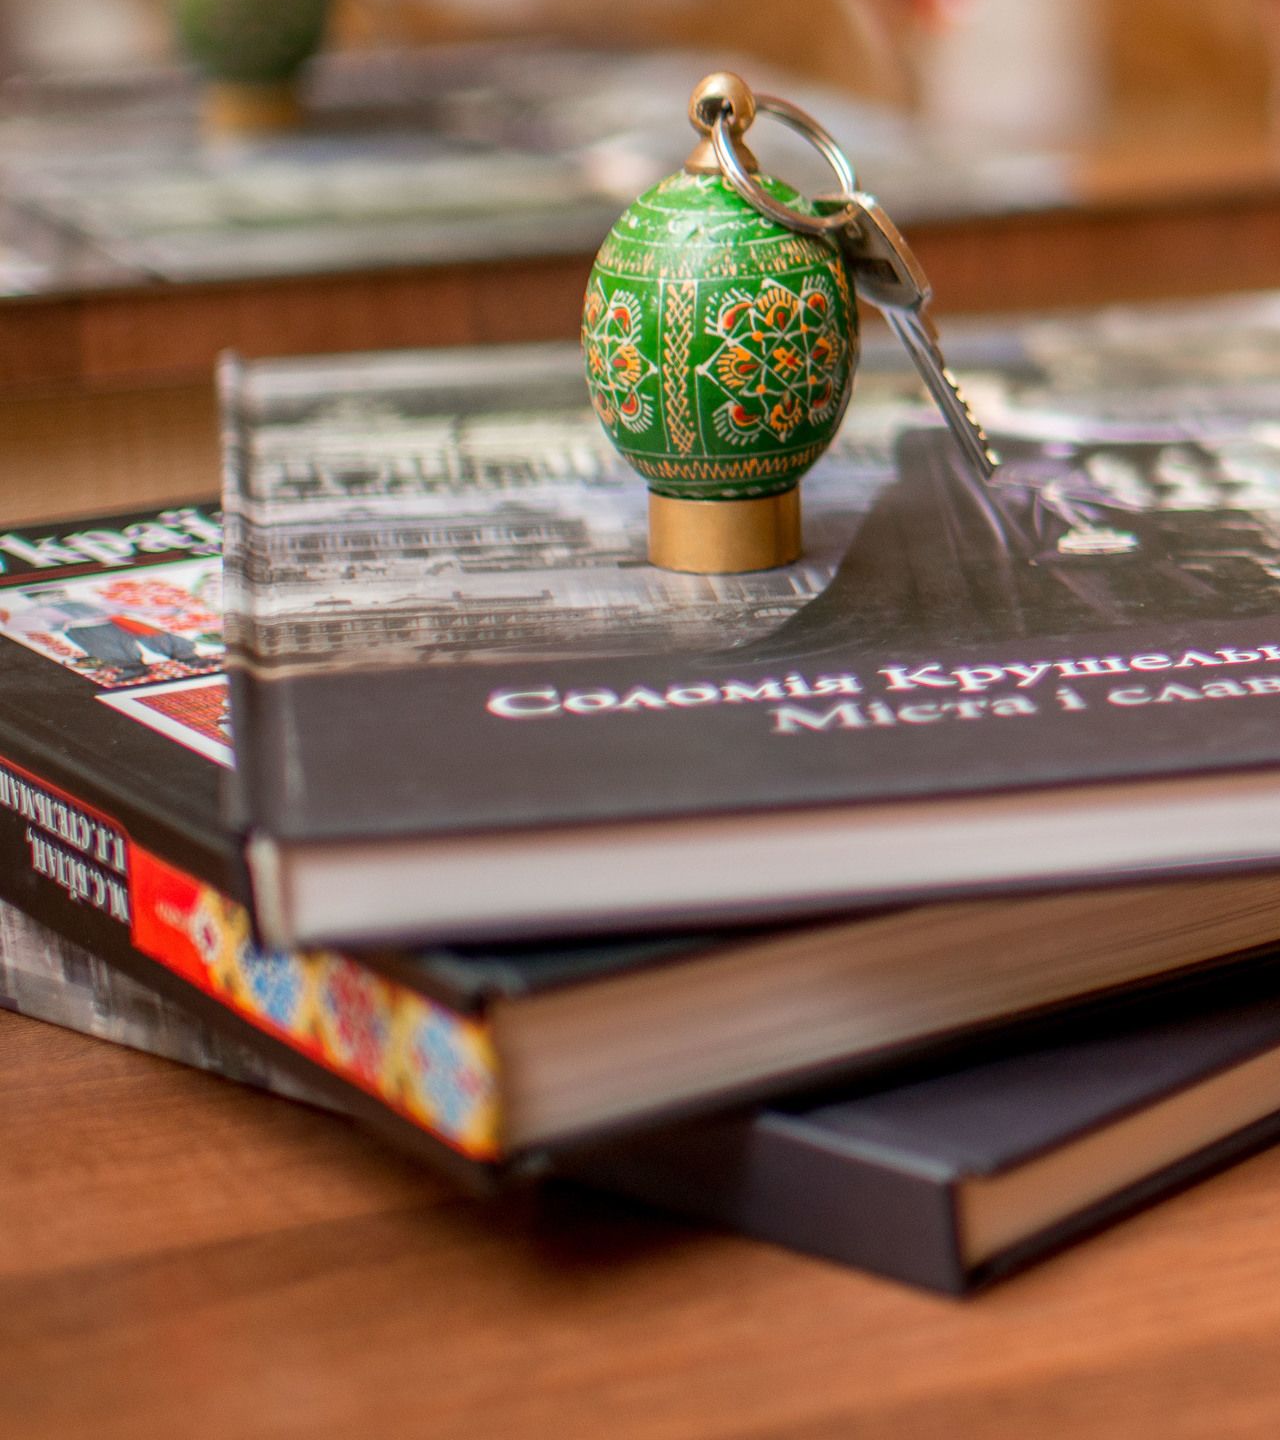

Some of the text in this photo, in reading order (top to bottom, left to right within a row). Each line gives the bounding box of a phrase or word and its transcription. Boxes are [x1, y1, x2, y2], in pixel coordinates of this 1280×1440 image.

[486, 672, 863, 720] Соломія
[768, 695, 1039, 734] Міста
[1055, 687, 1087, 711] і
